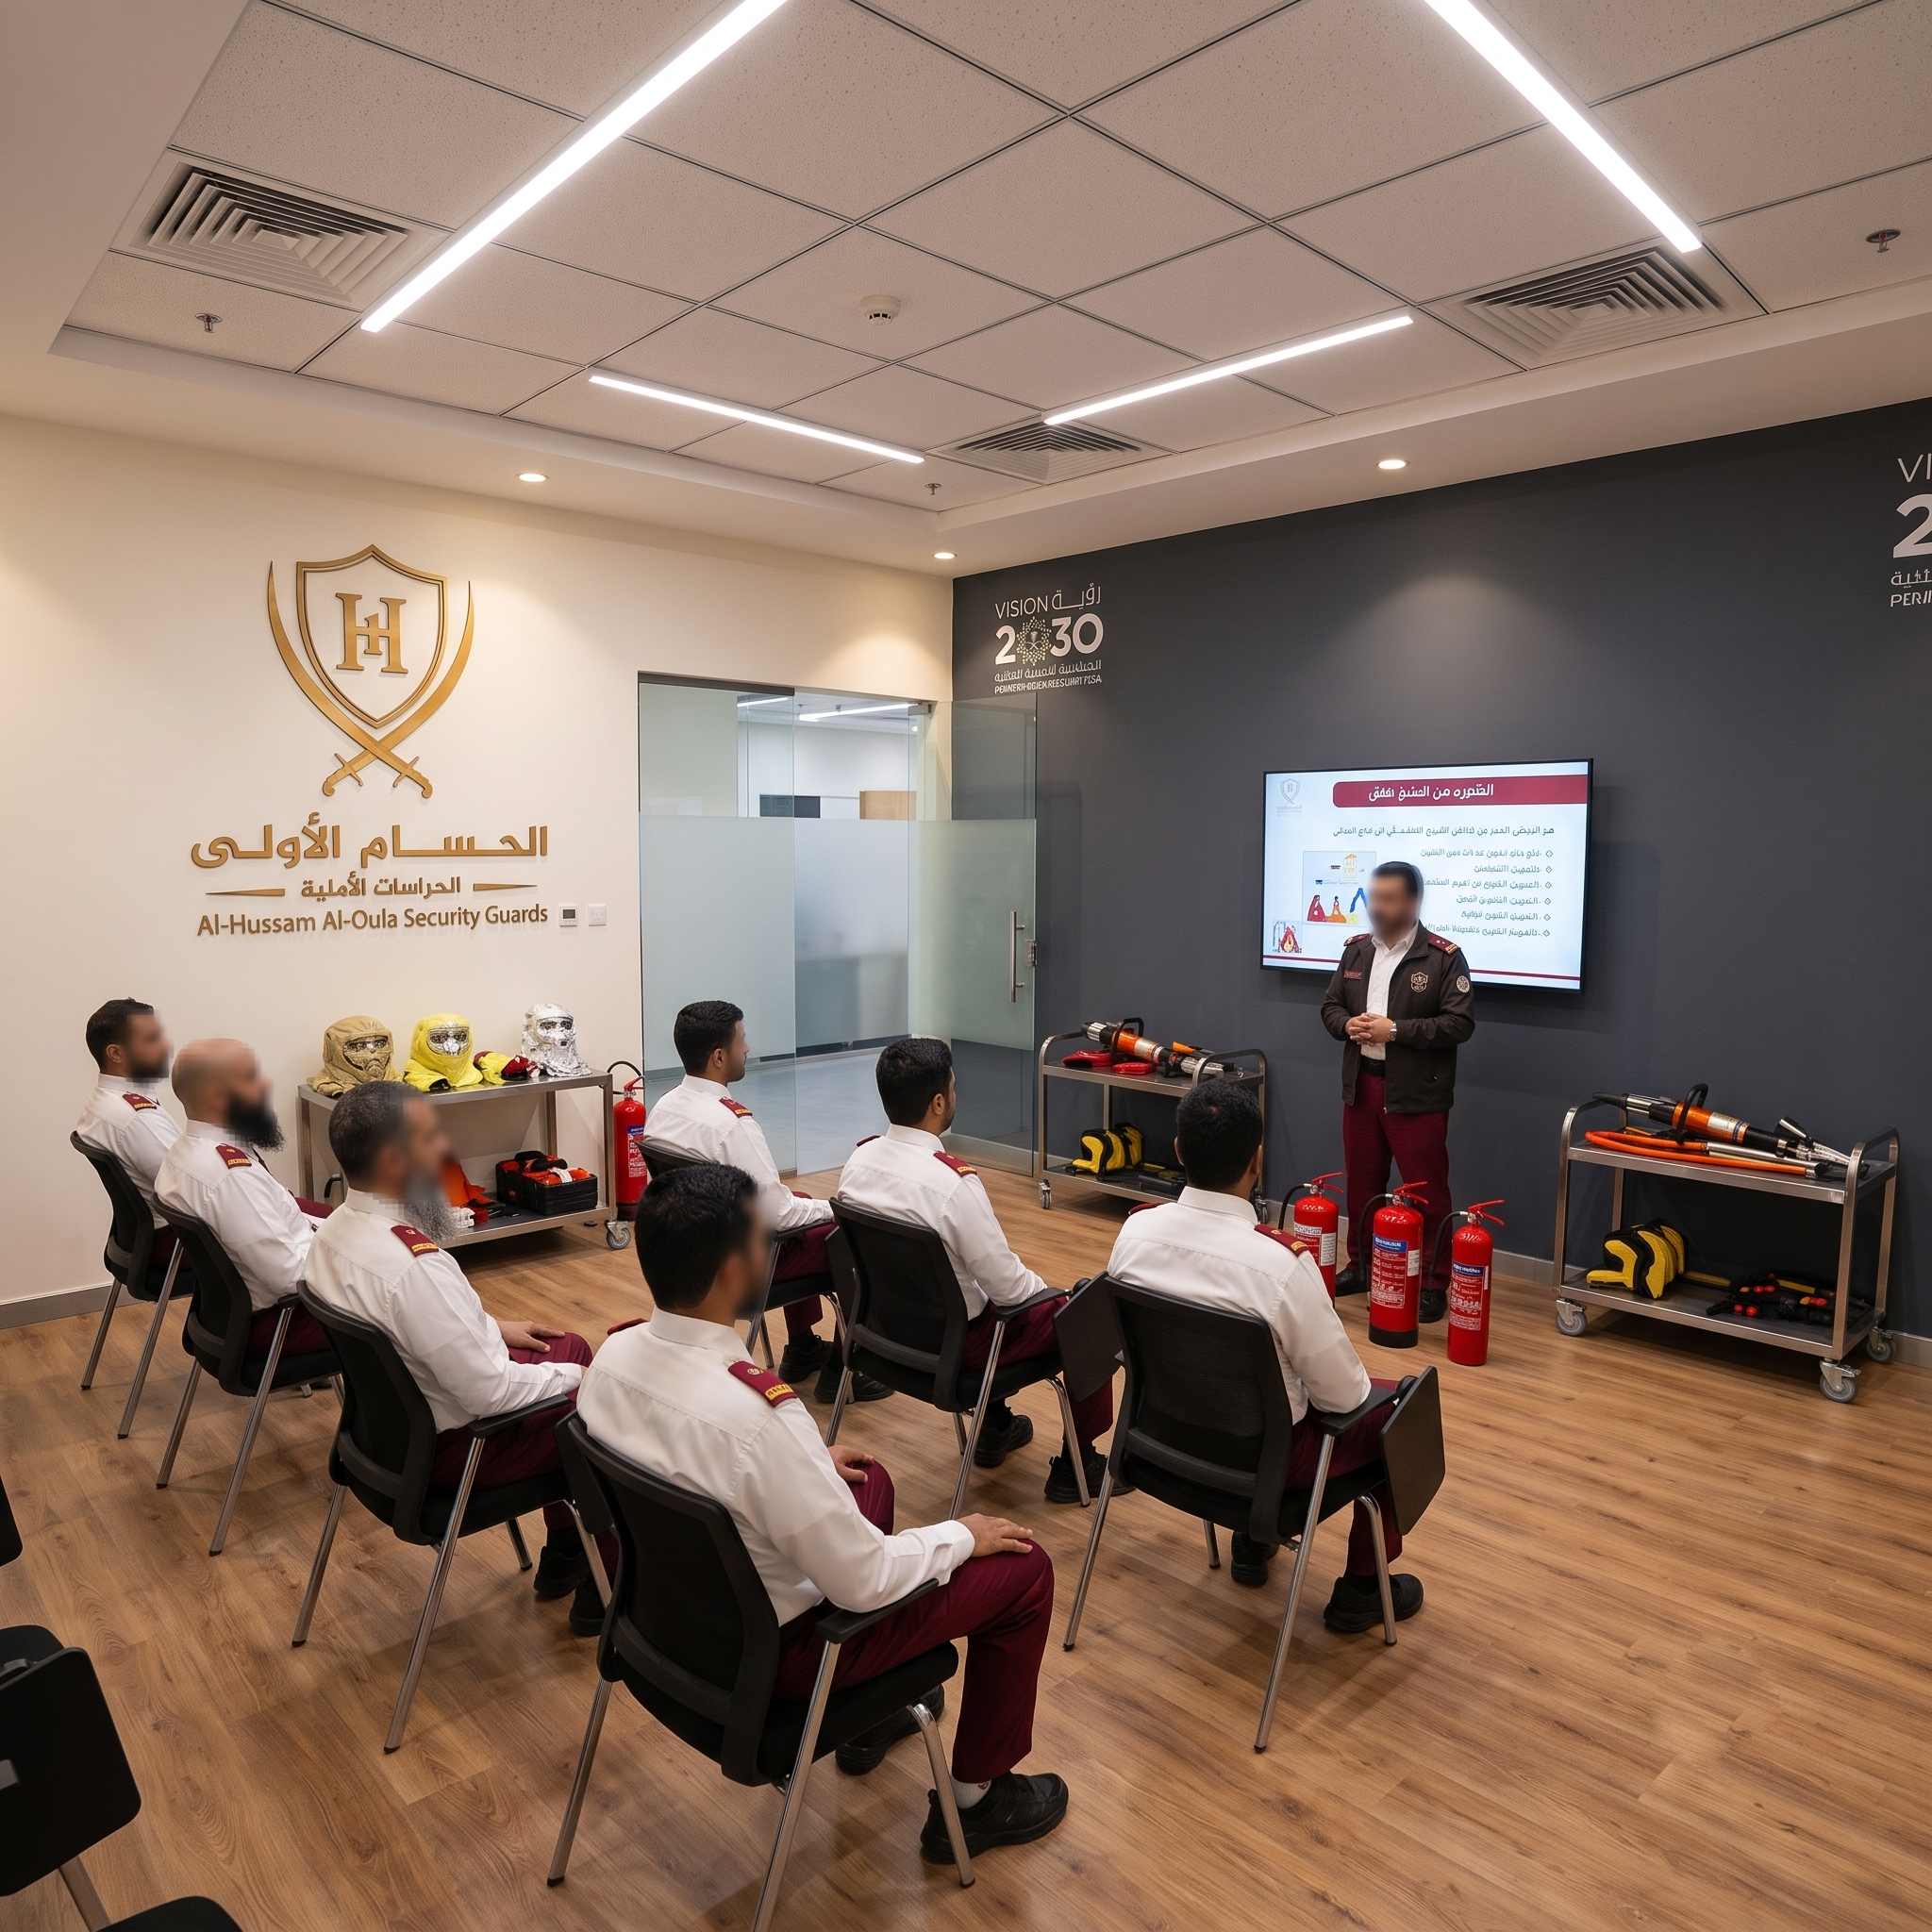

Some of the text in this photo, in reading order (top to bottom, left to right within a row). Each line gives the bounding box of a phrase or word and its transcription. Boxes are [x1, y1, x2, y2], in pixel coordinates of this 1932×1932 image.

[1897, 453, 1932, 483] VI
[1892, 493, 1932, 558] 2
[994, 595, 1048, 620] VISION
[191, 811, 548, 869] الحسام الأولى
[374, 875, 461, 900] الحراسات
[197, 903, 548, 937] Al-Hussam Al-Oula Security Guards
